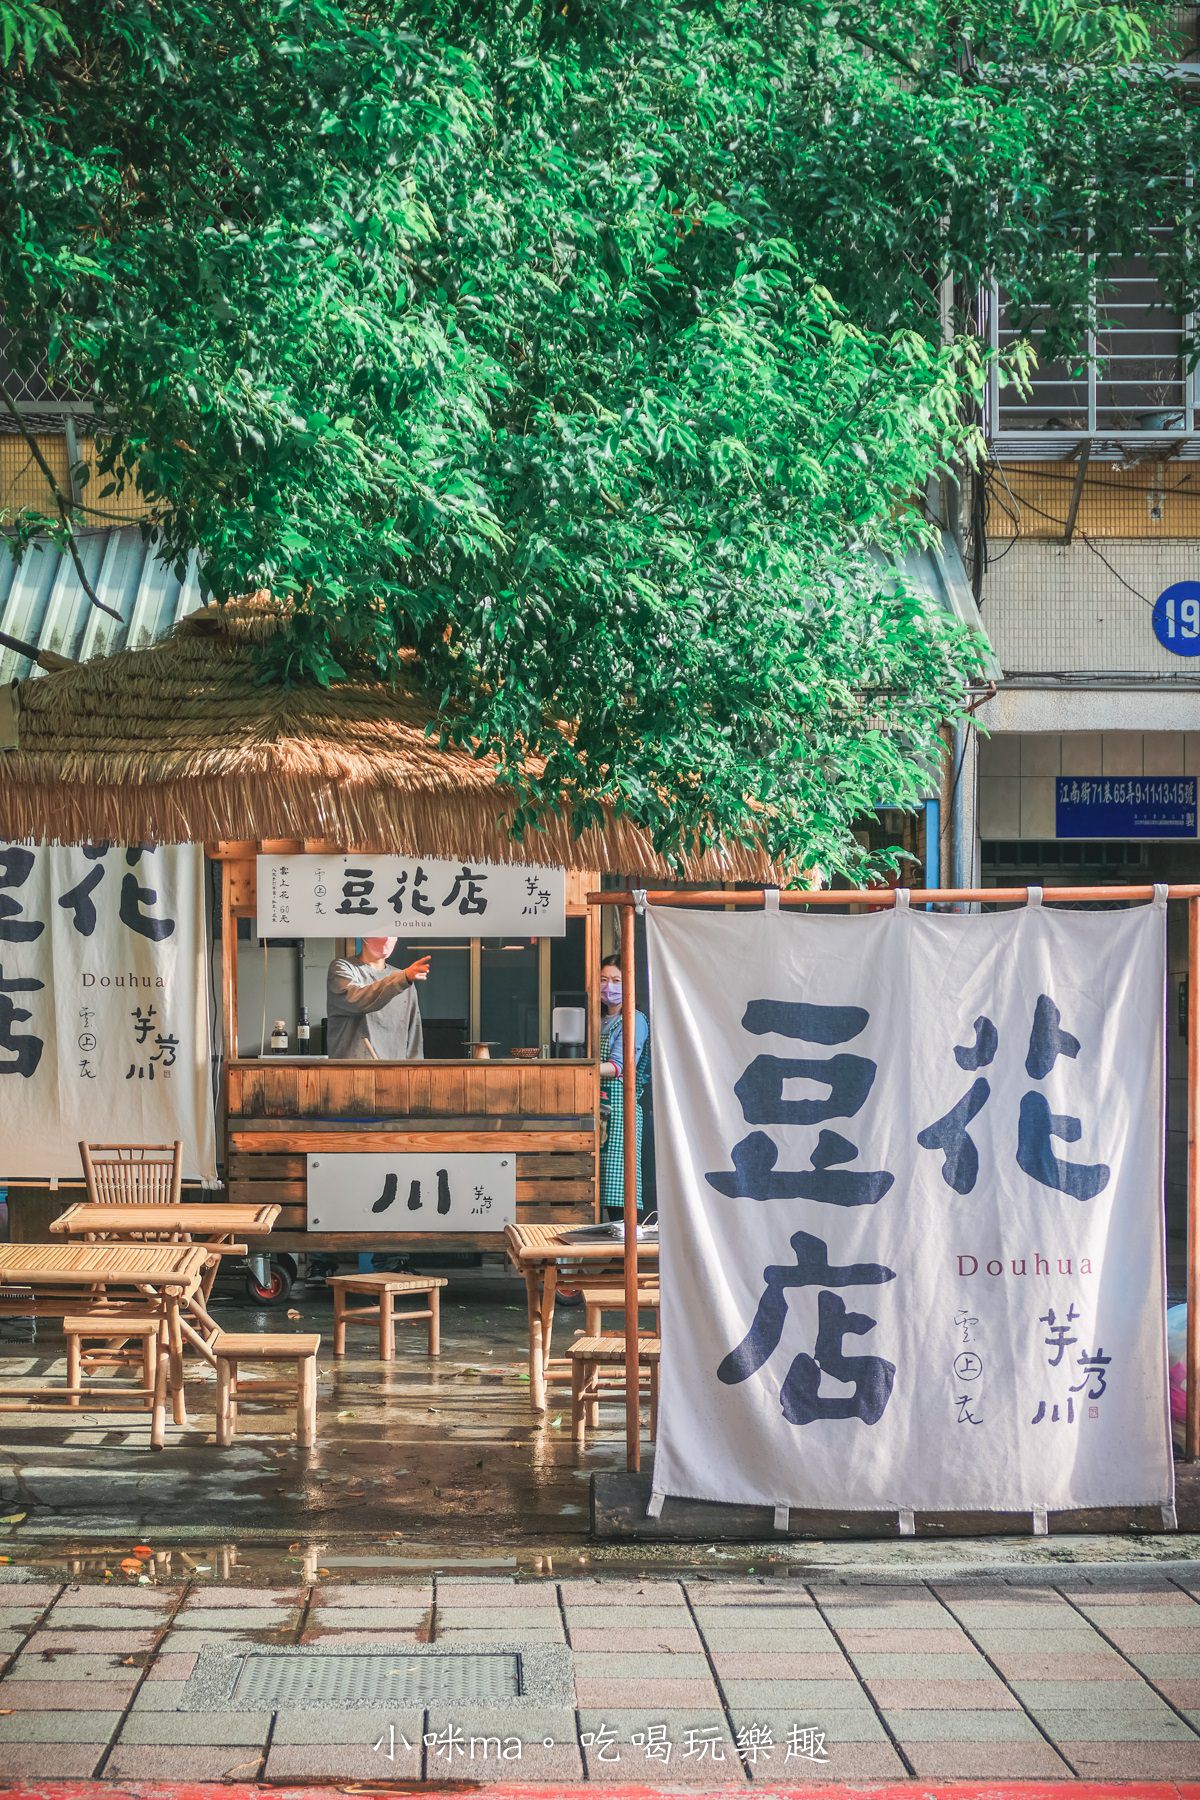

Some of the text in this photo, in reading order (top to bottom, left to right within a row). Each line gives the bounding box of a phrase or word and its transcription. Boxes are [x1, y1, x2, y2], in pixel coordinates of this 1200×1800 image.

[1166, 599, 1199, 638] 19
[335, 866, 488, 916] 豆花店
[394, 920, 432, 928] Douhua
[82, 973, 165, 988] Douhua
[371, 1168, 452, 1215] 川
[956, 1253, 1093, 1277] Douhua
[716, 1230, 897, 1426] 店
